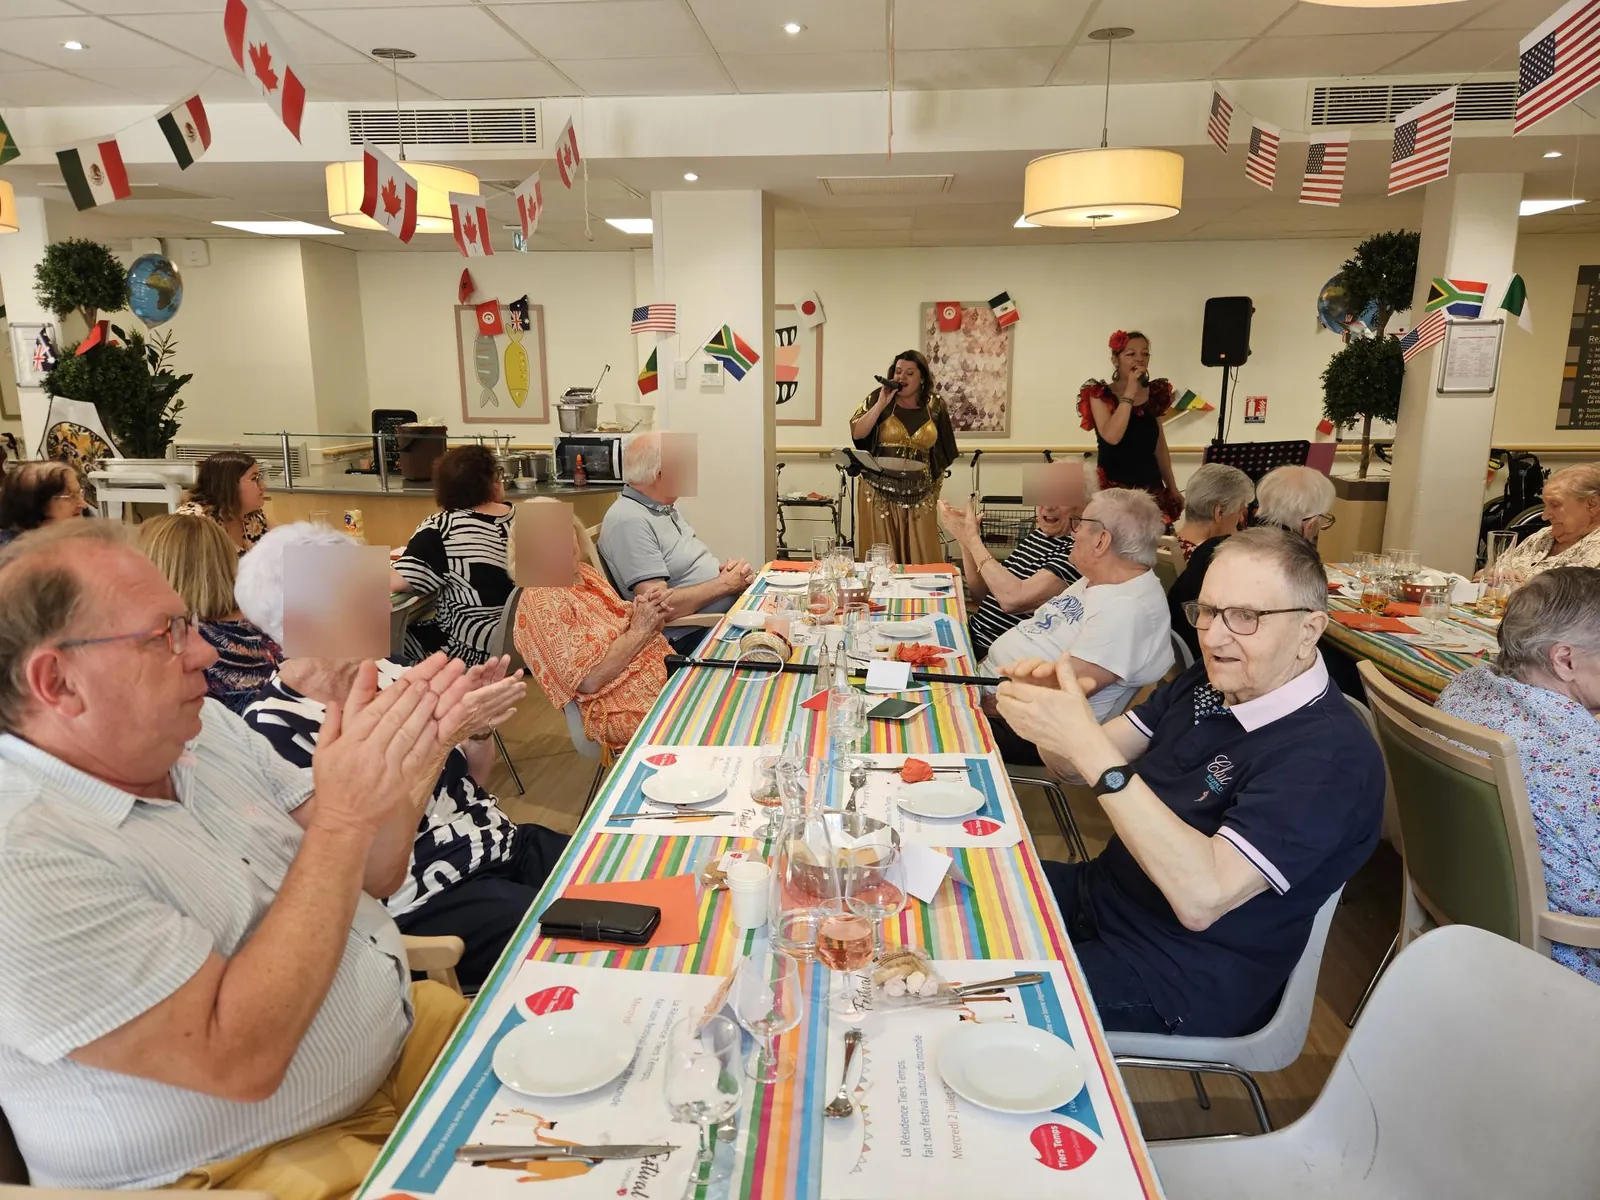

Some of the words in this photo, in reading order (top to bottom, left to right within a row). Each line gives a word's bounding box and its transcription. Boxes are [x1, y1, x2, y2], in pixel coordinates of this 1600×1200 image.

[912, 1034, 924, 1060] monde
[915, 1061, 925, 1071] du
[897, 1086, 908, 1104] Tiers
[917, 1072, 928, 1097] autour
[918, 1098, 931, 1126] festival
[899, 1105, 911, 1146] Résidence
[922, 1127, 932, 1142] son
[948, 1121, 963, 1160] Mercredi
[1050, 1125, 1063, 1148] Temps
[900, 1147, 912, 1158] La
[921, 1143, 934, 1158] fait
[1058, 1149, 1069, 1168] Tiers
